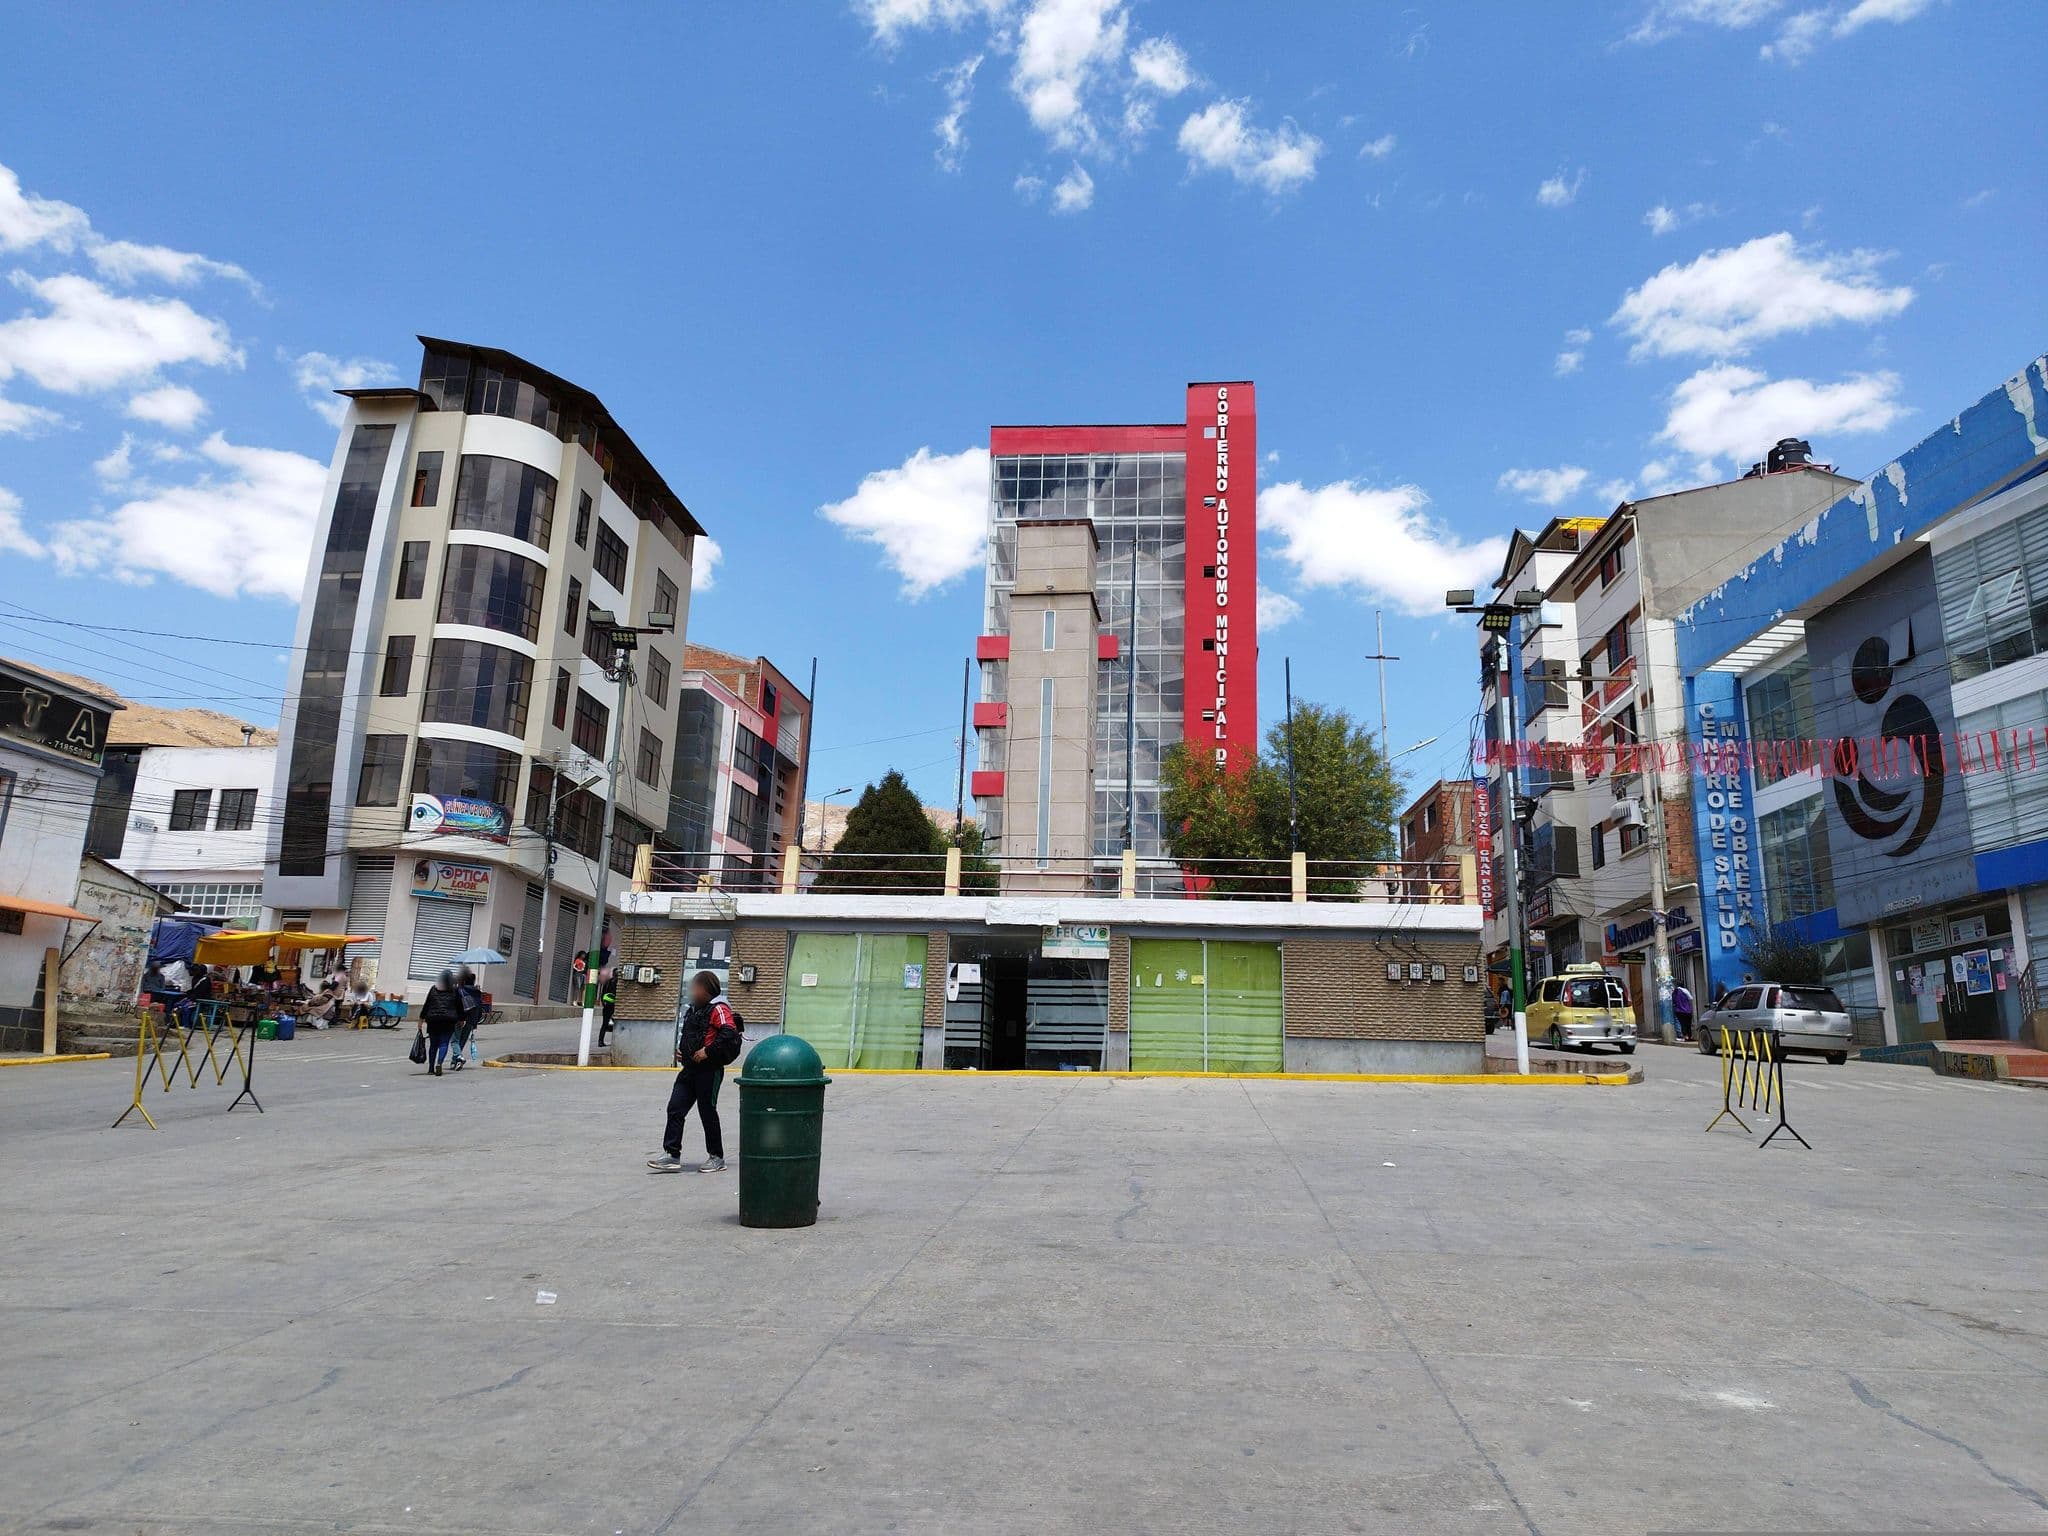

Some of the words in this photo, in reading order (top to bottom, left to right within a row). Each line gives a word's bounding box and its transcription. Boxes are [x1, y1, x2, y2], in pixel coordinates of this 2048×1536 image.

[1216, 386, 1228, 492] GOBIERNO
[1216, 498, 1228, 606] AUTONOMO
[1215, 614, 1228, 739] MUNICIPAL
[1701, 703, 1724, 808] CENTRO
[1721, 722, 1743, 808] MADRE
[469, 802, 478, 816] DE
[1710, 814, 1727, 849] DE
[439, 866, 490, 883] OPTICA
[450, 880, 478, 890] LOOK
[1480, 849, 1491, 876] GRAN
[1715, 855, 1737, 948] SALUD
[1730, 816, 1753, 928] OBRERA
